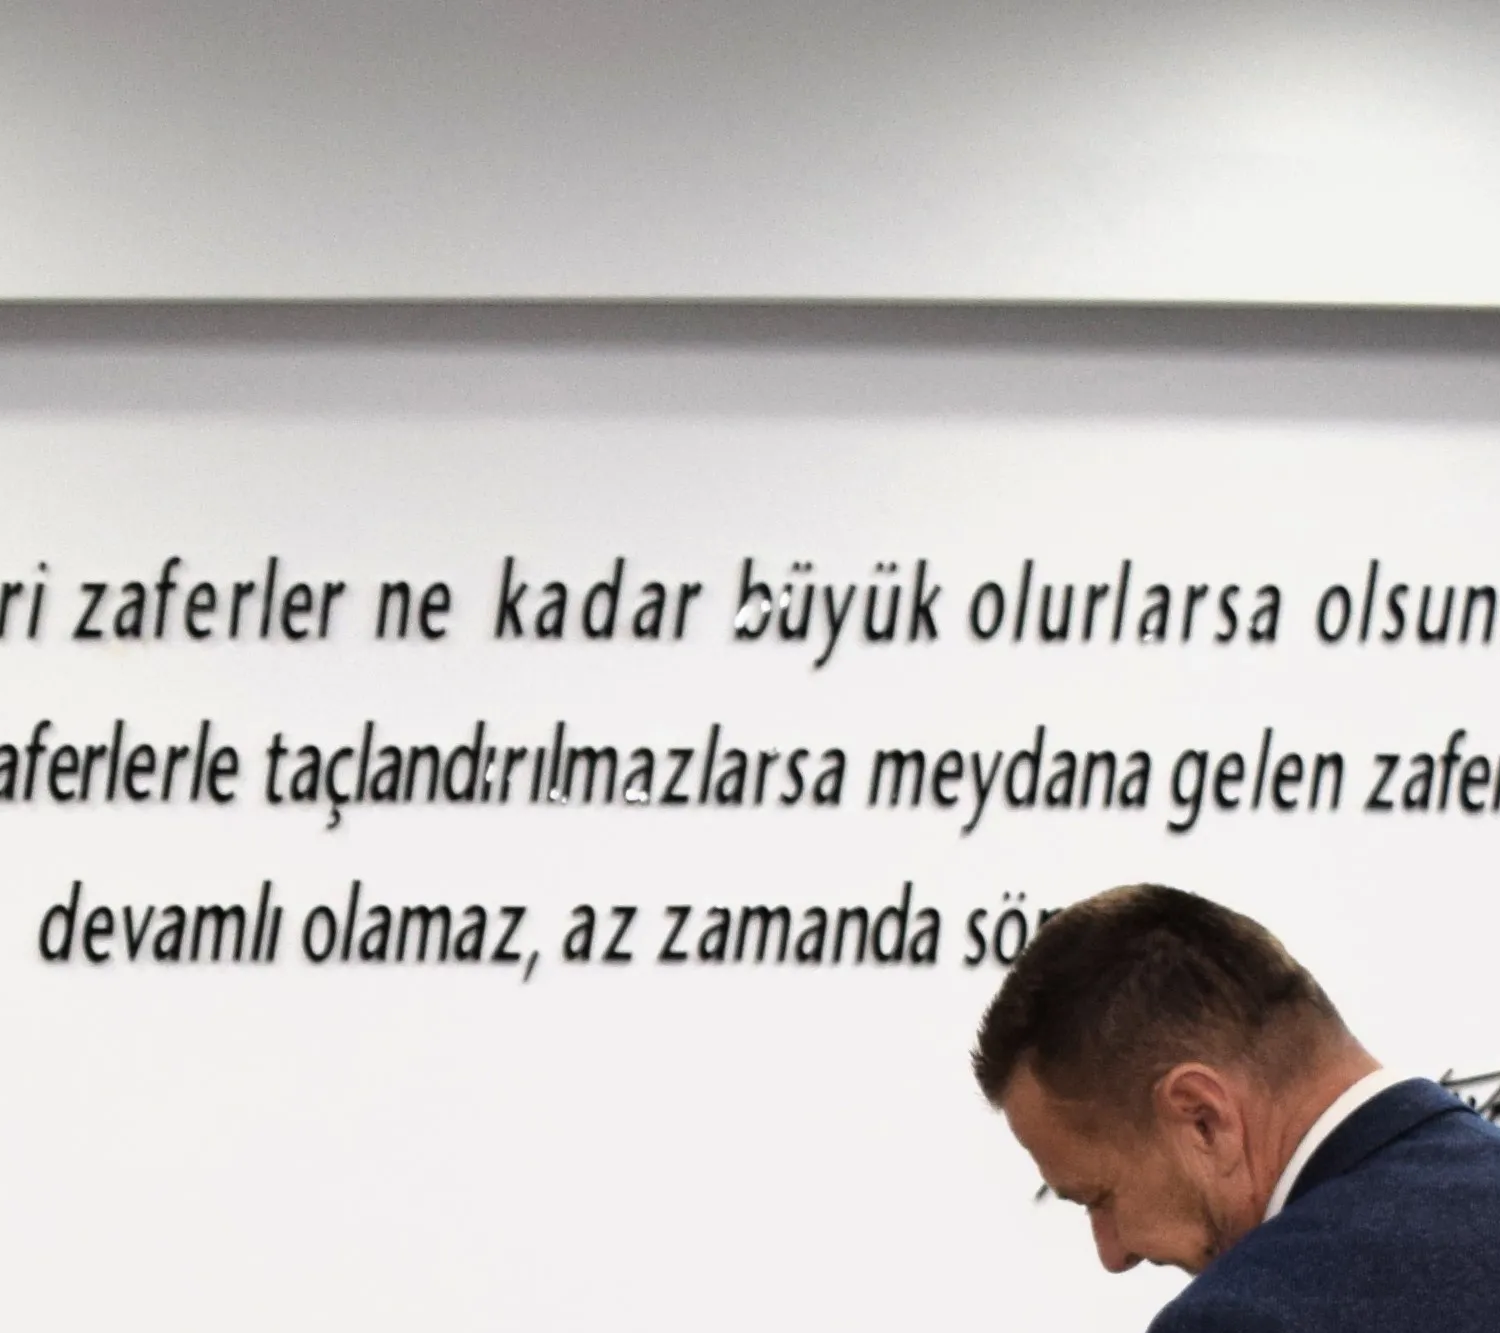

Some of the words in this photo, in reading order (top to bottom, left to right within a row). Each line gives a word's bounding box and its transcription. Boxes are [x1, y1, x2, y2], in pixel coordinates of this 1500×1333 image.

[72, 555, 347, 643] zaferler
[375, 580, 452, 642] ne
[493, 555, 704, 641] kadar
[734, 556, 942, 670] büyük
[968, 558, 1282, 644] olurlarsa
[265, 719, 847, 831] taçlandırılmazlarsa
[868, 724, 1152, 836] meydana
[1167, 726, 1345, 836] gelen
[38, 879, 284, 965] devamlı
[301, 879, 540, 983] olamaz,
[562, 903, 639, 964] az
[657, 880, 942, 966] zamanda
